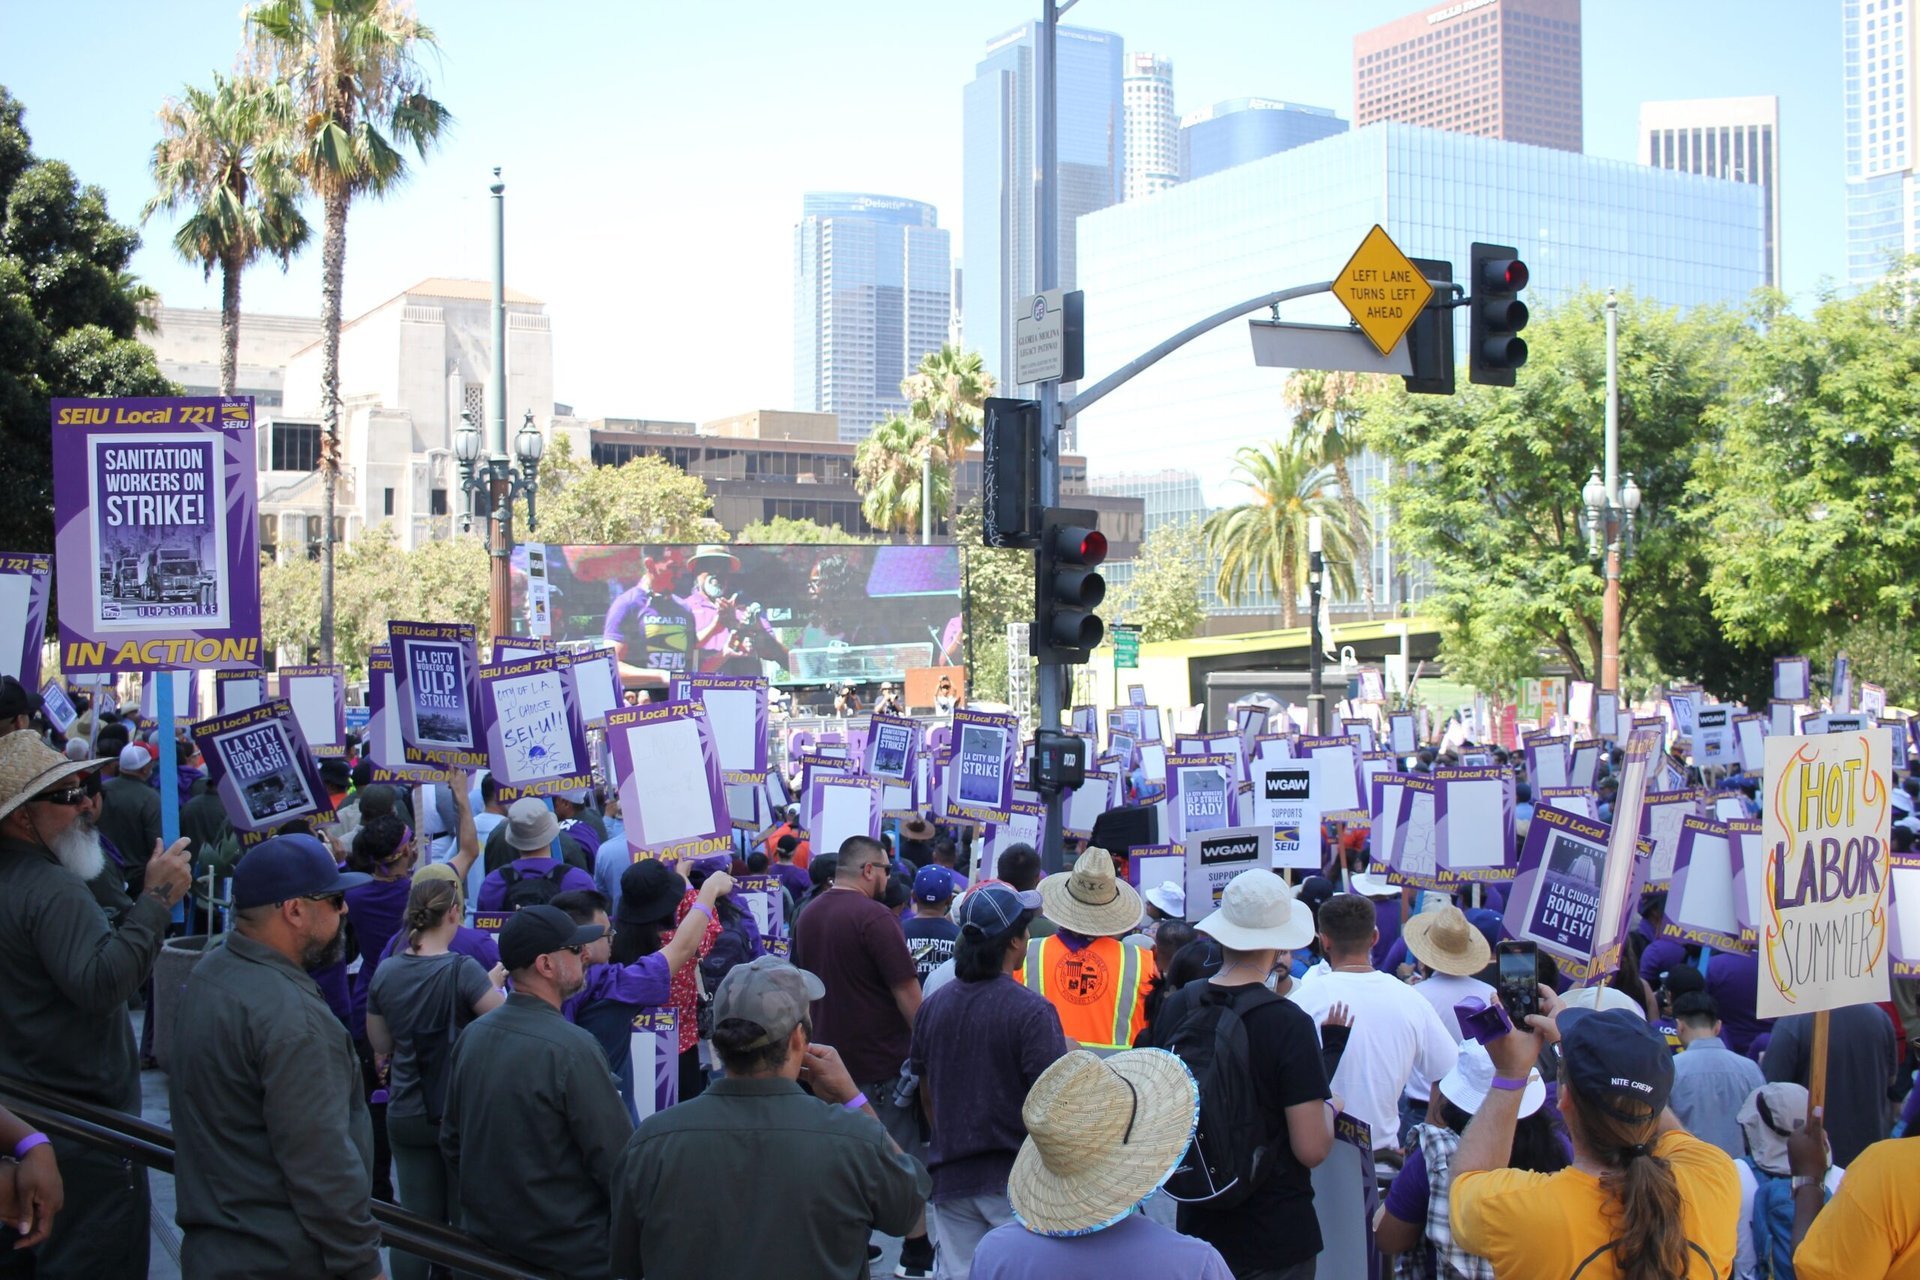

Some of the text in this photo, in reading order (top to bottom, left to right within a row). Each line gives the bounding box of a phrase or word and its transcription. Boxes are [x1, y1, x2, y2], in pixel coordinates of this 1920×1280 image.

[1352, 269, 1411, 283] LEFT LANE
[1350, 287, 1417, 301] TURNS LEFT
[1367, 306, 1403, 319] AHEAD
[58, 407, 215, 424] SEIU Local 721
[222, 420, 250, 429] SEIU
[105, 448, 203, 471] SANITATION
[106, 472, 204, 492] WORKERS ON
[107, 495, 205, 526] STRIKE!
[7, 558, 29, 571] 721
[137, 604, 218, 617] ULP STRIKE
[643, 616, 687, 625] LOCAL 721
[391, 625, 458, 639] SEIU Local 721
[66, 637, 259, 667] IN ACTION!
[415, 650, 454, 665] LA CITY
[504, 661, 532, 675] Local
[534, 658, 553, 671] 721
[647, 653, 686, 669] SEIU
[416, 663, 455, 673] WORKERS ON
[418, 671, 456, 695] ULP
[692, 679, 753, 687] SEIU Local 721
[420, 694, 459, 709] STRIKE
[195, 707, 272, 737] SEIU Local 721
[609, 714, 636, 726] SEIU
[640, 708, 669, 721] Local
[672, 705, 689, 716] 721
[954, 712, 1006, 725] SEIU Local 721
[224, 727, 276, 755] LA CITY
[880, 740, 905, 750] STRIKE!
[1303, 737, 1350, 748] SEIU Local 721
[230, 740, 282, 767] DON'T BE
[406, 748, 488, 766] IN ACTION!
[963, 752, 1000, 764] LA CITY ULP
[235, 754, 289, 780] TRASH!
[1167, 757, 1185, 765] SEIU
[1209, 756, 1223, 764] 721
[373, 769, 392, 781] IN
[963, 762, 999, 778] STRIKE
[1436, 769, 1499, 779] SEIU Local 721
[815, 776, 869, 785] SEIU Local 721
[1266, 779, 1308, 791] WGAW
[1373, 774, 1392, 783] SEIU
[1406, 780, 1427, 789] SEIU
[499, 775, 592, 801] IN ACTION!
[1798, 759, 1862, 832] HOT
[948, 804, 1010, 822] IN ACTION!
[1187, 803, 1223, 816] READY
[1271, 808, 1303, 818] SUPPORTS
[1536, 809, 1605, 839] SEIU Local
[1685, 819, 1708, 830] SEIU
[1729, 822, 1749, 831] SEIU
[1172, 845, 1184, 855] IN
[1203, 842, 1257, 857] WGAW
[1274, 842, 1300, 851] SEIU
[1372, 863, 1386, 873] IN
[1775, 835, 1881, 910] LABOR
[1389, 873, 1403, 884] IN
[1438, 868, 1516, 882] IN ACTION!
[746, 880, 763, 890] 721
[1546, 894, 1597, 924] ROMPIÓ
[476, 918, 502, 928] SEIU
[1542, 909, 1594, 940] LA LEY!
[1663, 924, 1683, 937] IN
[1741, 929, 1756, 940] IN
[1780, 908, 1875, 992] SUMMER
[1893, 963, 1909, 974] IN
[1659, 1026, 1678, 1035] LOC
[1611, 1077, 1654, 1094] NITE CREW
[1339, 1120, 1355, 1138] 721
